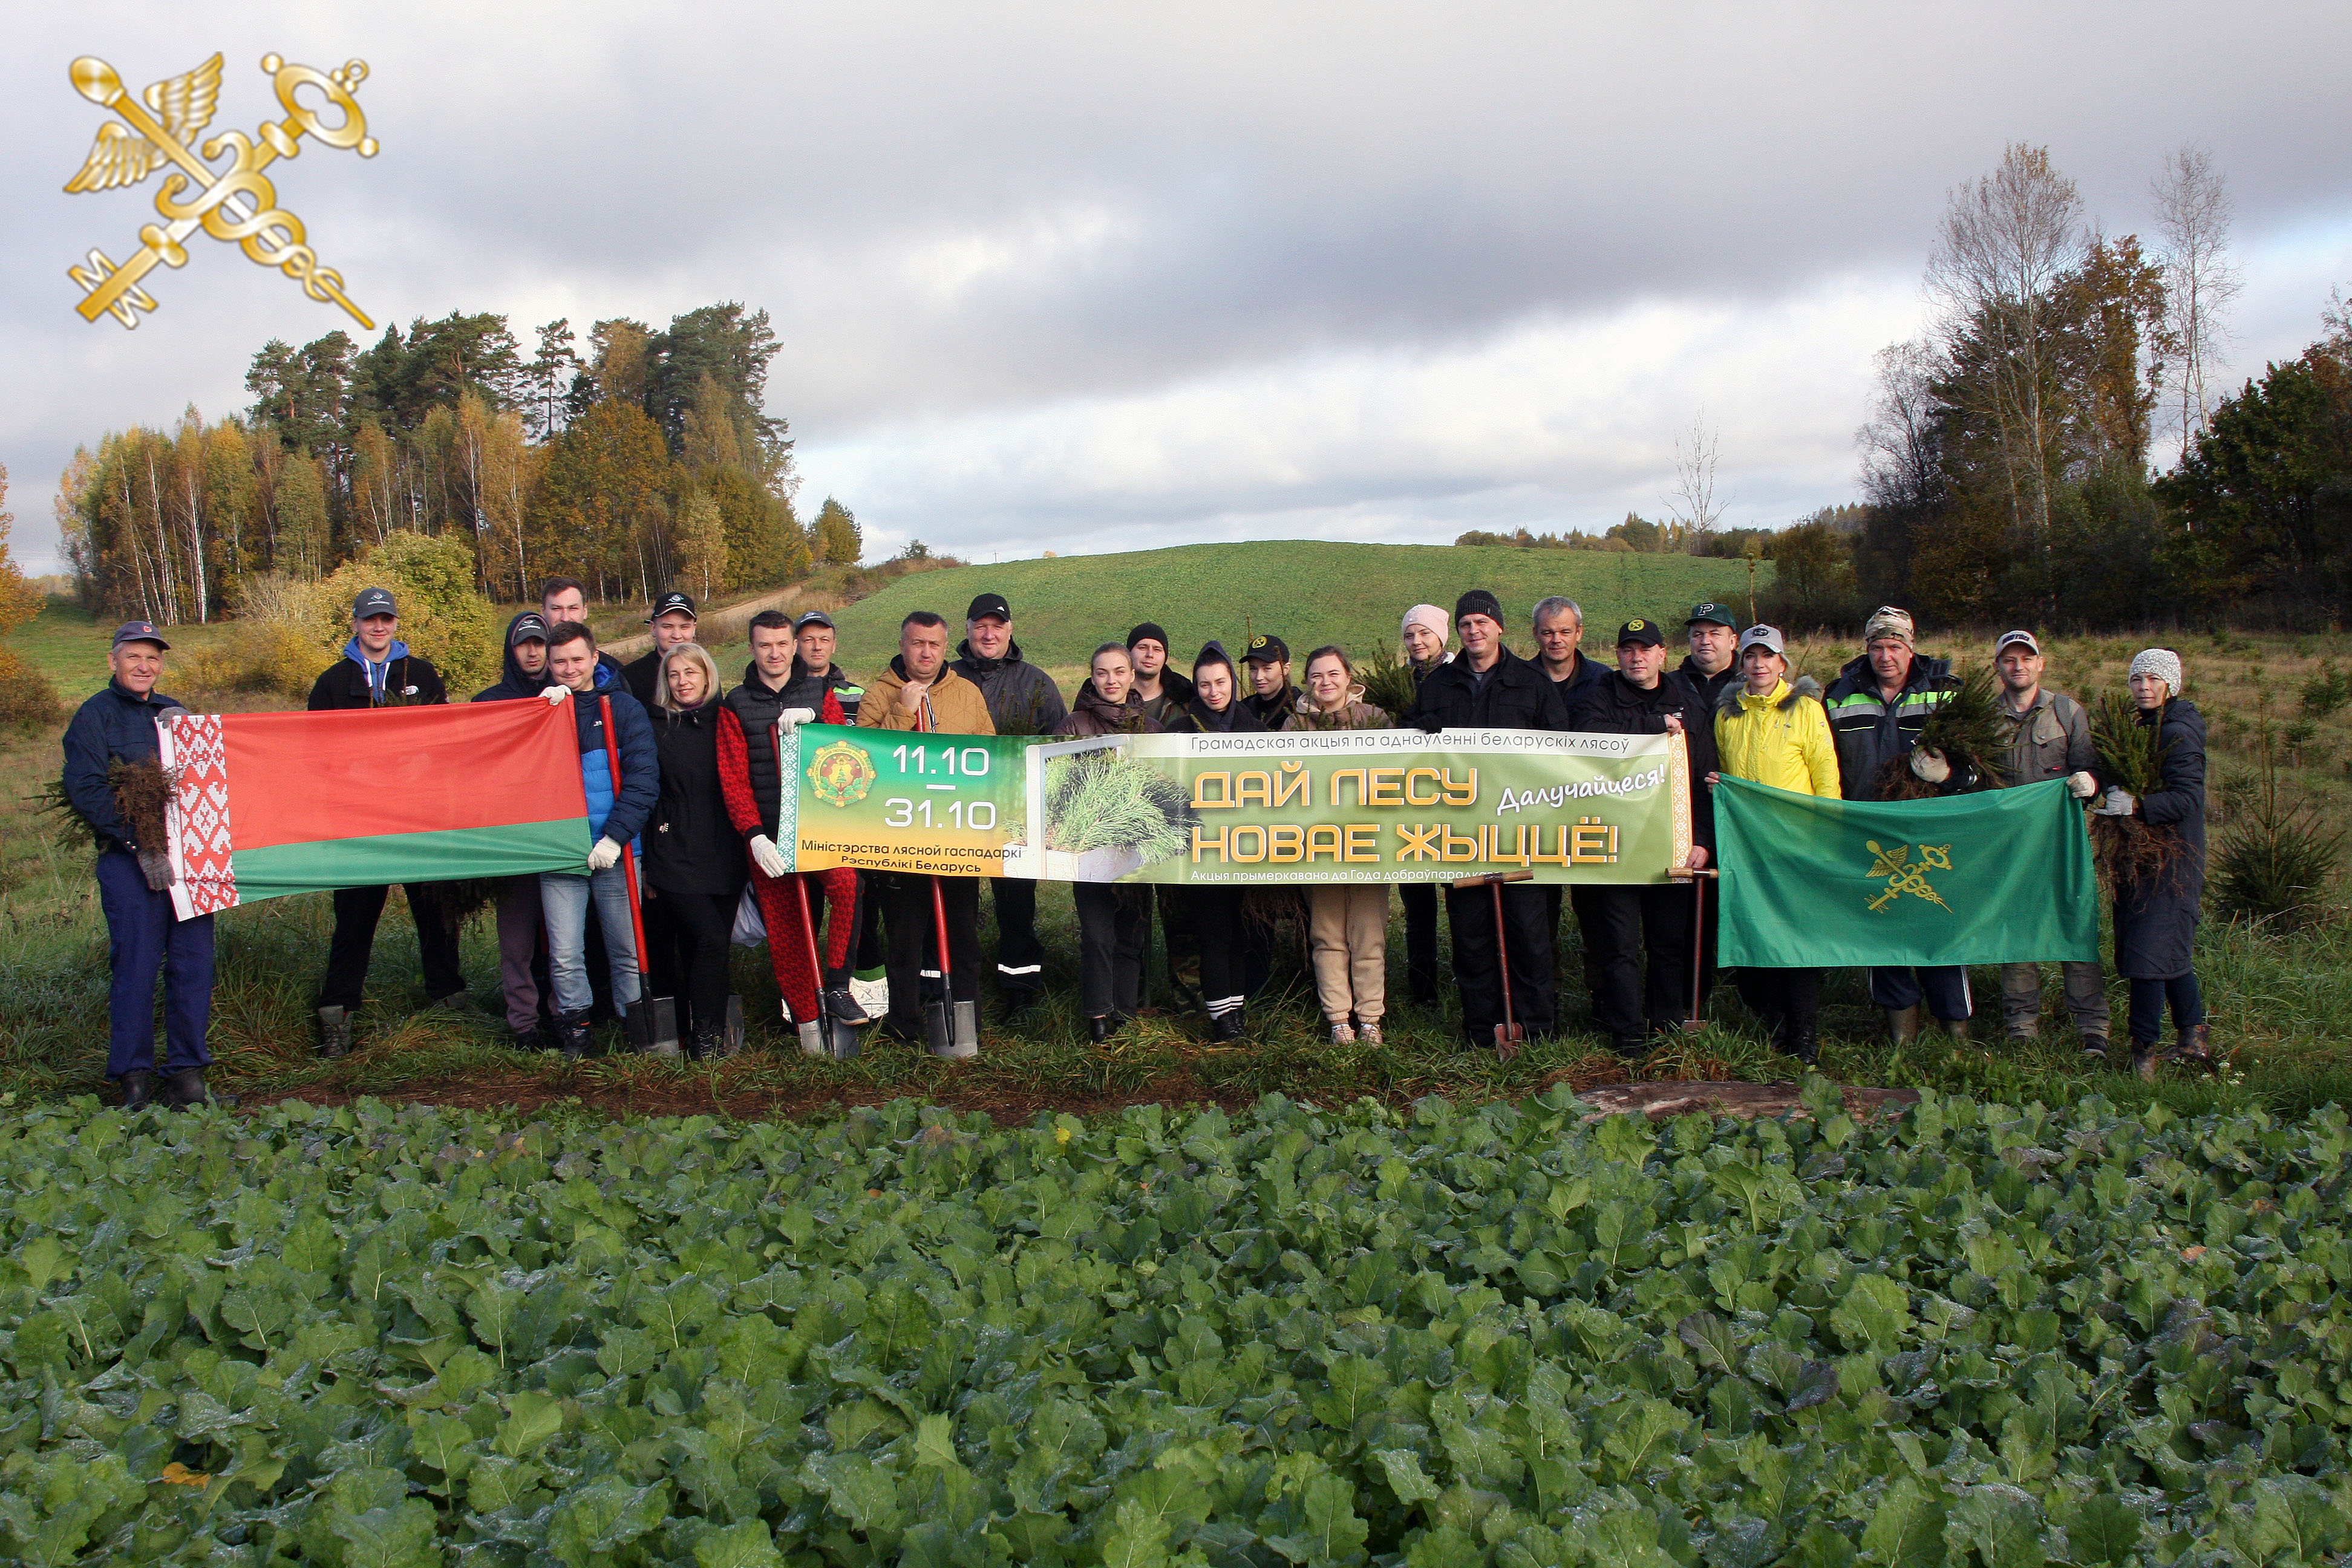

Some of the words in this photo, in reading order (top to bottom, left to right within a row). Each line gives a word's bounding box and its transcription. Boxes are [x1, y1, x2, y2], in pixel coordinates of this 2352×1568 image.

[1191, 736, 1296, 752] Грамадская
[1299, 736, 1349, 750] акцыя
[1354, 736, 1375, 748] па
[1481, 732, 1575, 748] беларускіх
[1580, 735, 1630, 754] лясоў
[892, 744, 990, 777] 11.10
[1190, 760, 1311, 808] ДАЙ
[1330, 767, 1478, 806] ЛЕСУ
[1497, 764, 1666, 815] Далучайцеся!
[883, 797, 997, 831] 31.10
[802, 839, 889, 855] Міністэрства
[892, 843, 941, 857] лясной
[945, 847, 1022, 860] гаспадаркі
[1192, 823, 1381, 864] НОВАЕ
[1396, 817, 1619, 867] ЖЫЦЦЁ!
[841, 855, 912, 869] Рэспублікі
[916, 860, 981, 873] Беларусь
[1191, 871, 1229, 882] Акцыя
[1232, 871, 1328, 883] прымеркавана
[1331, 871, 1348, 882] да
[1350, 870, 1381, 881] Года
